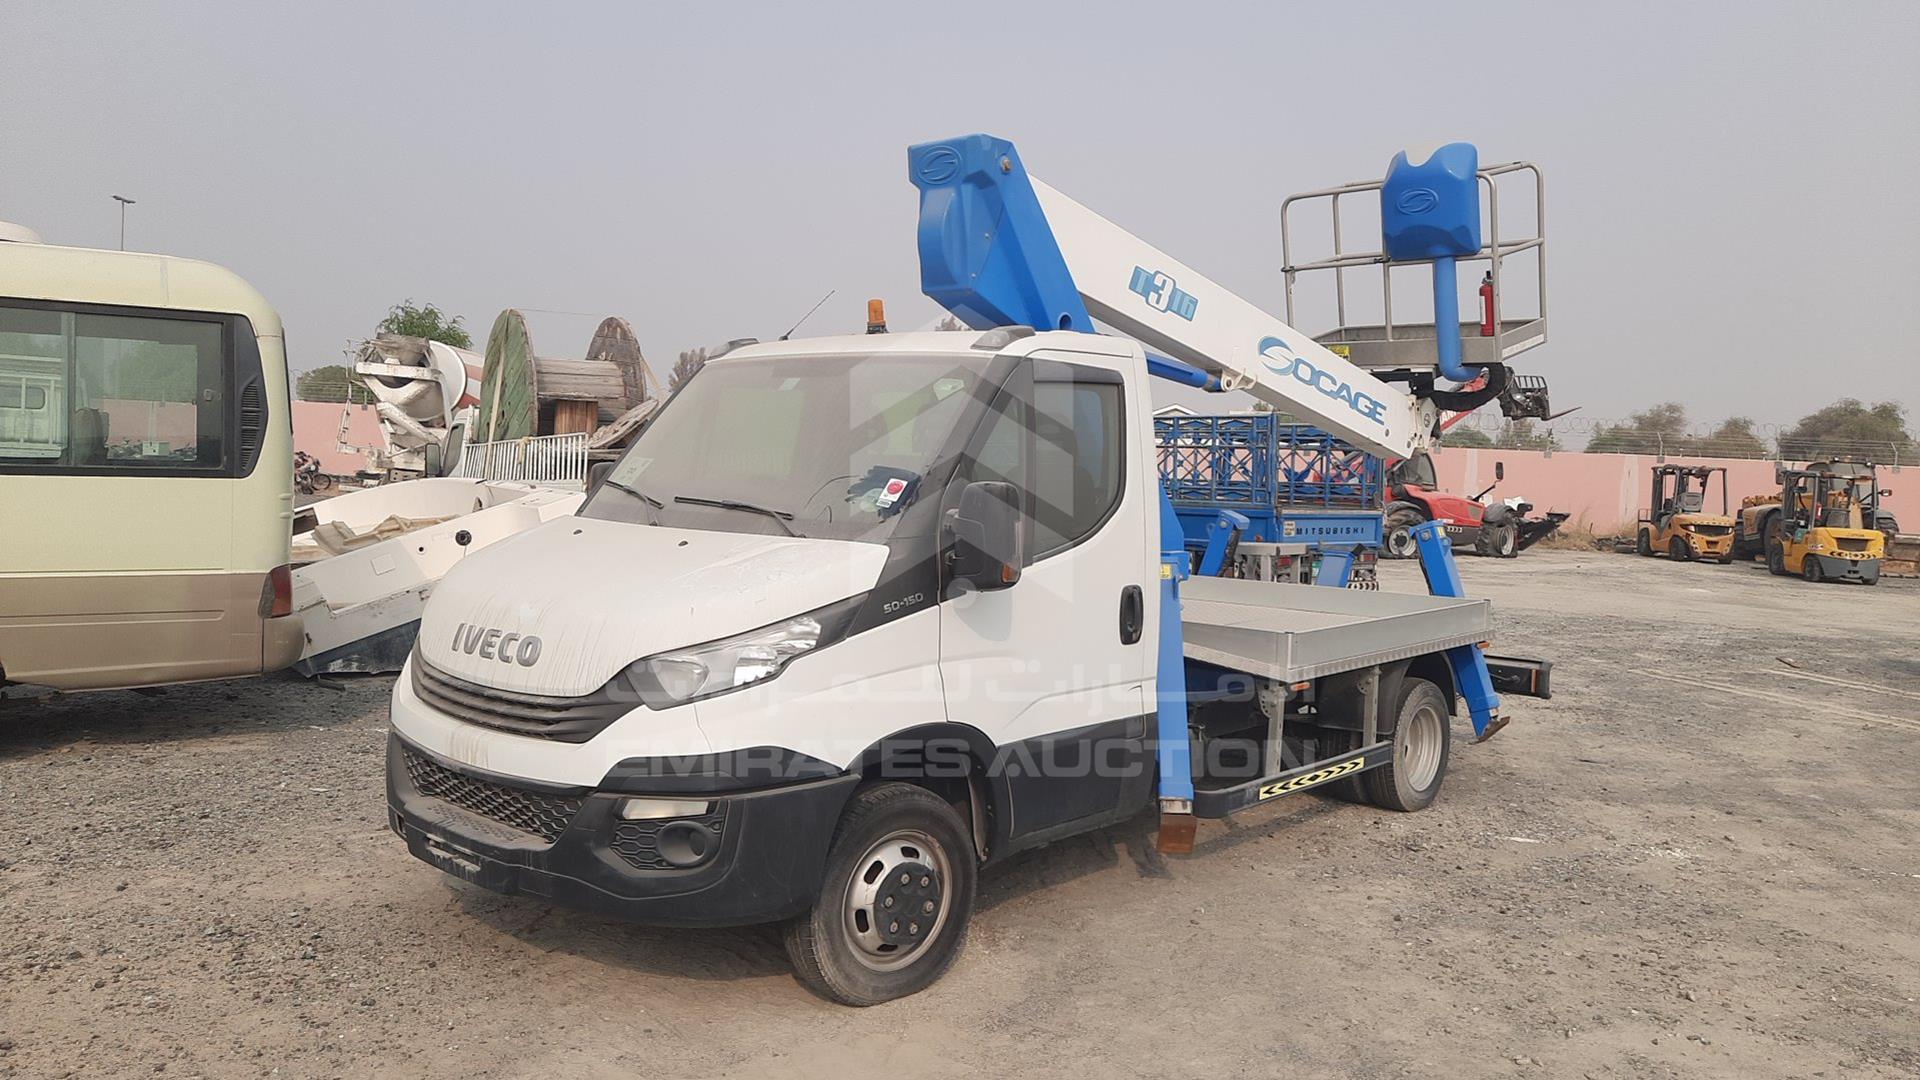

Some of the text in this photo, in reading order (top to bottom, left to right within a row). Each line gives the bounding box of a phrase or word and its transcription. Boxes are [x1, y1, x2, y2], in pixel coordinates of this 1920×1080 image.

[1258, 335, 1387, 425] SOCAGE
[883, 592, 924, 614] 50-150
[451, 622, 543, 667] IVECO
